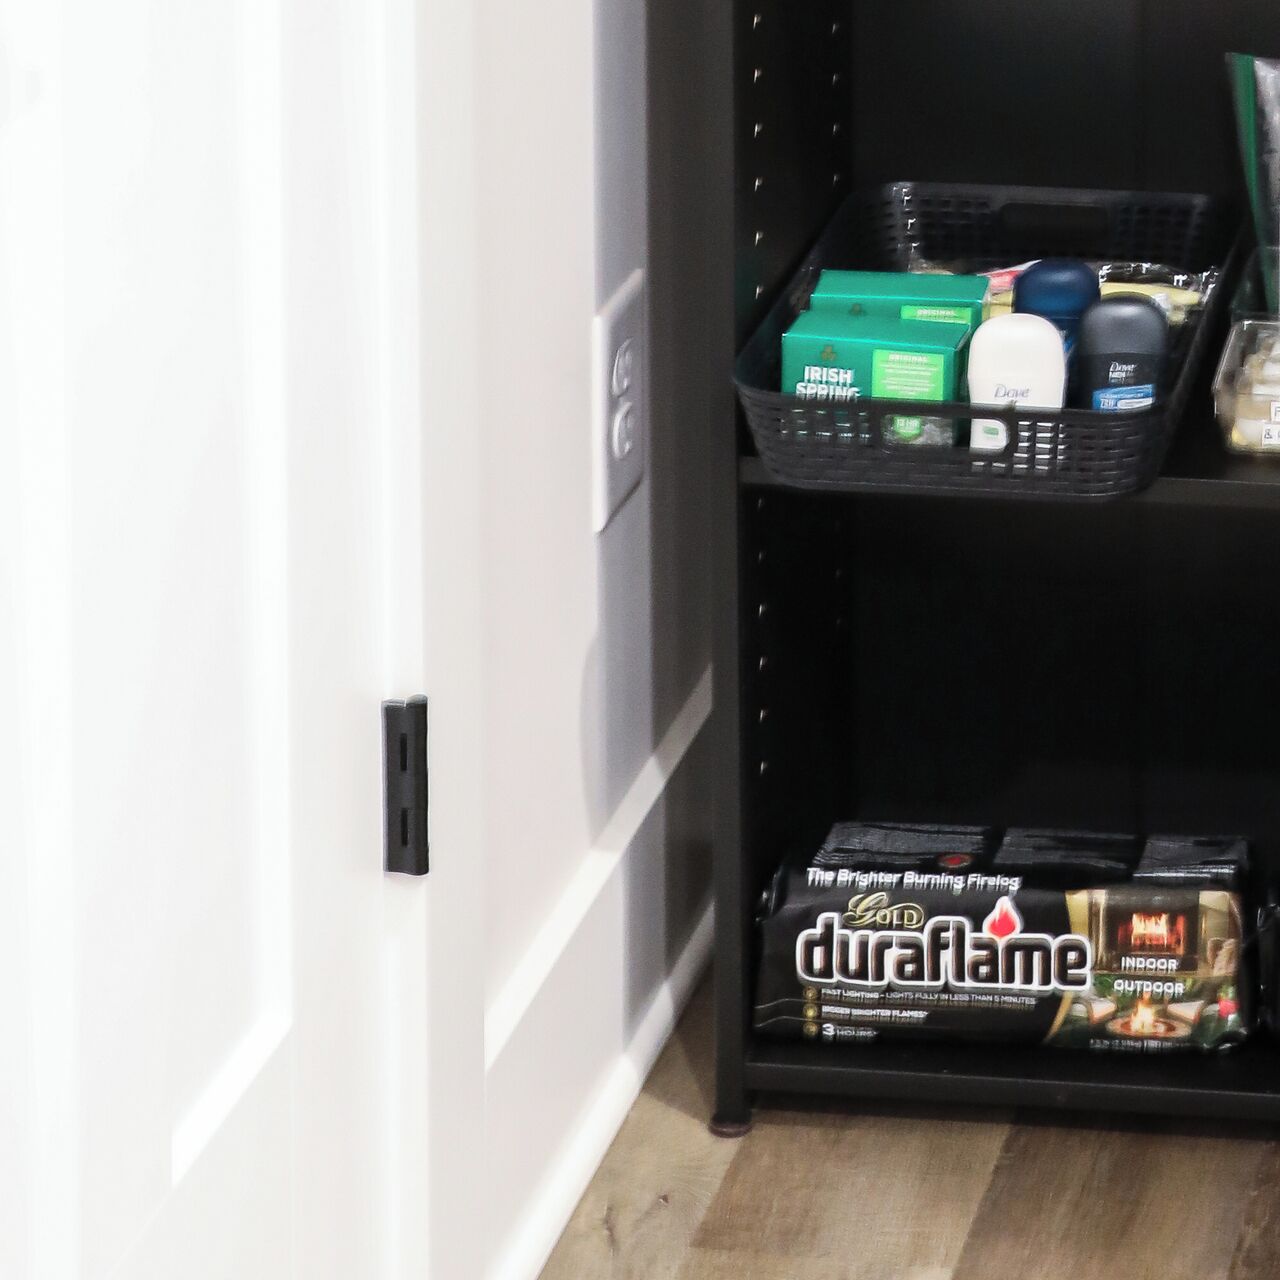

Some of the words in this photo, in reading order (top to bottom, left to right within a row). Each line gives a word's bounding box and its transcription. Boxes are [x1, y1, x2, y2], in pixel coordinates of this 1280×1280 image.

[804, 366, 855, 384] IRISH
[994, 384, 1030, 399] Dove
[1263, 428, 1273, 439] &
[806, 867, 834, 883] The
[837, 868, 902, 887] Brighter
[904, 870, 965, 889] Burning
[967, 873, 1021, 890] Firelog
[796, 911, 1094, 991] duraflame
[1121, 956, 1179, 971] INDOOR
[821, 988, 841, 997] FAST
[1113, 979, 1186, 994] OUTDOOR
[822, 1023, 835, 1037] 3
